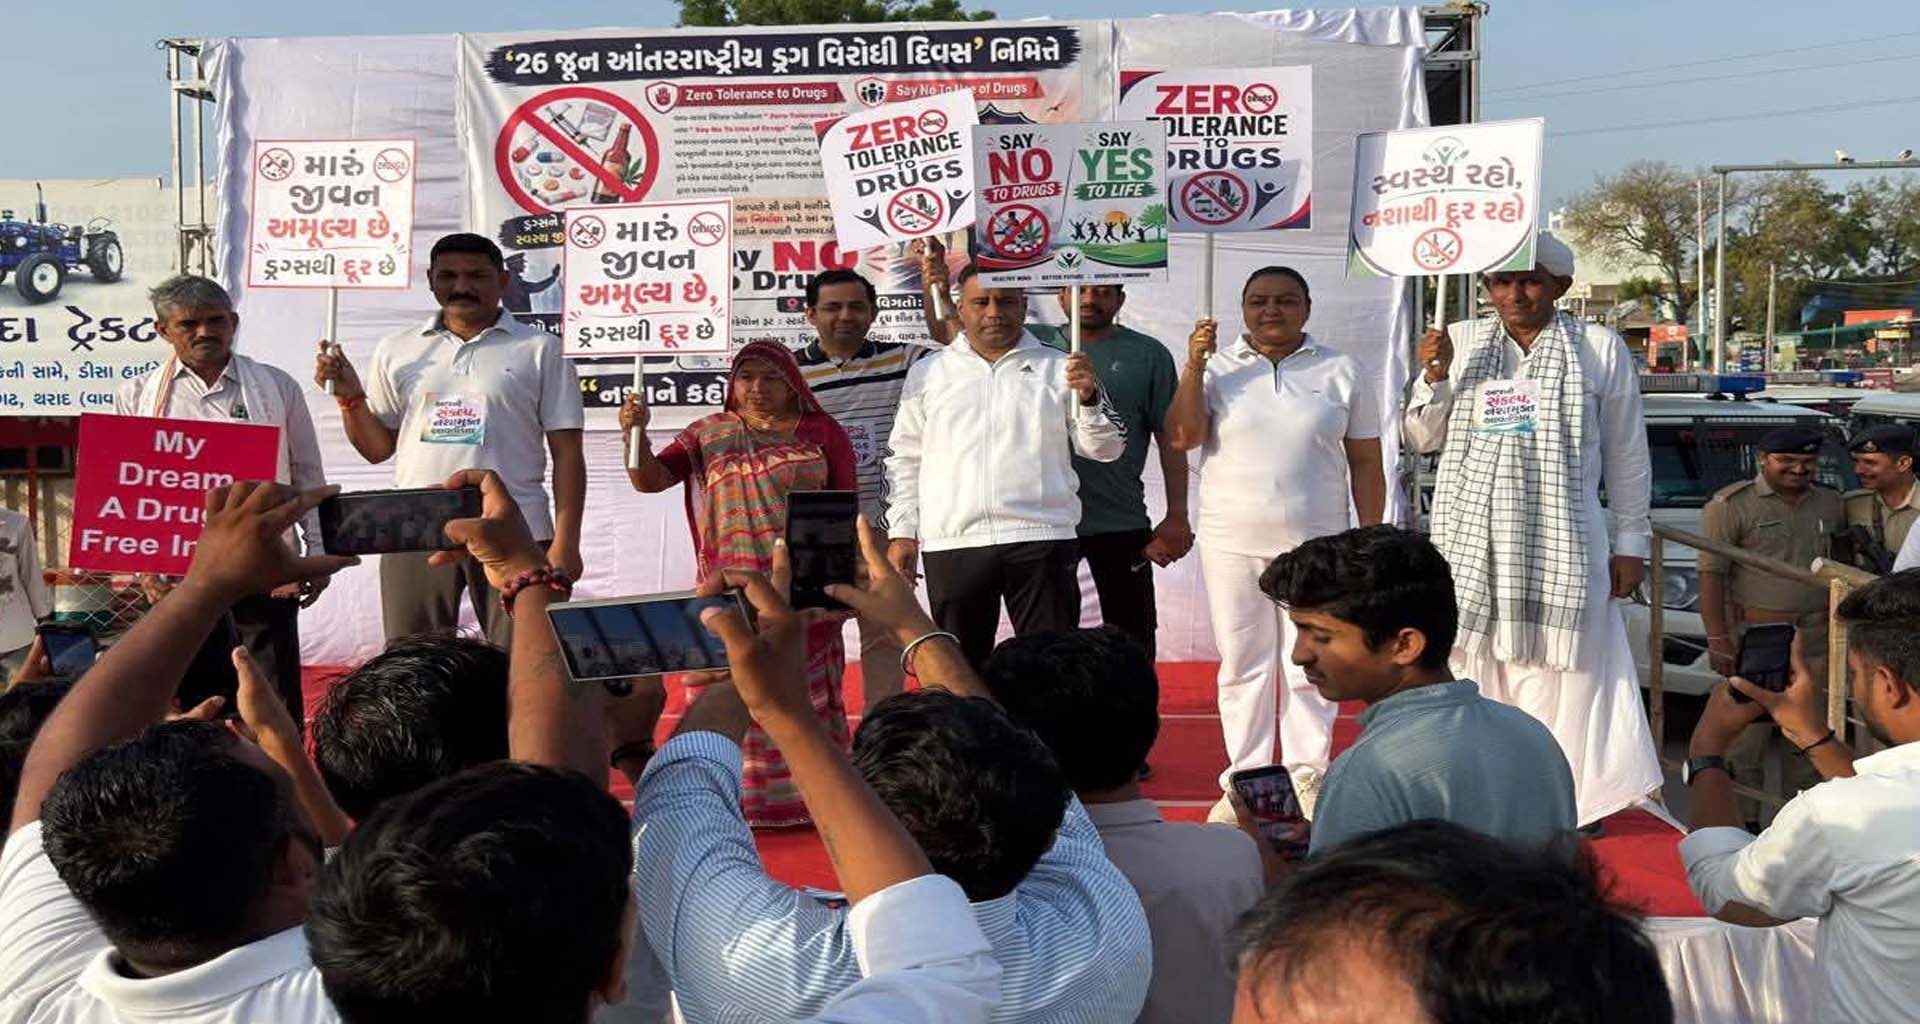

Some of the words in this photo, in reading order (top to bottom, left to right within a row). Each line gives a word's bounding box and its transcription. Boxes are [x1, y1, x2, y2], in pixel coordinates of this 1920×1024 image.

[555, 51, 599, 82] જૂન
[607, 43, 763, 75] આંતરરાષ્ટ્રીય
[772, 47, 809, 73] ડ્રગ
[818, 34, 898, 67] વિરોધી
[686, 89, 713, 101] Zero
[716, 88, 775, 100] Tolerance
[777, 88, 790, 98] to
[792, 87, 828, 100] Drugs
[896, 84, 917, 99] Say
[920, 83, 937, 96] No
[979, 82, 991, 94] of
[992, 82, 1028, 96] Drugs
[1099, 132, 1132, 147] SAY
[1146, 115, 1287, 137] OLERANCE
[844, 131, 962, 171] TOLERANCE
[1000, 133, 1034, 150] SAY
[1203, 138, 1229, 148] TO
[304, 148, 365, 177] મારું
[896, 160, 916, 171] TO
[988, 148, 1053, 186] NO
[1078, 148, 1153, 182] YES
[1371, 164, 1454, 195] સ્વસ્થ
[1466, 156, 1523, 190] રહો,
[855, 160, 963, 197] DRUGS
[991, 187, 1008, 201] TO
[1012, 184, 1055, 199] DRUGS
[1087, 185, 1105, 198] TO
[1111, 183, 1144, 197] LIFE
[289, 185, 381, 214] જીવન
[1362, 196, 1438, 228] નશાથી
[1444, 200, 1475, 229] દૂર
[1483, 192, 1525, 223] રહો
[267, 218, 357, 248] અમૂલ્ય
[367, 210, 399, 243] છે,
[616, 213, 679, 242] મારું
[264, 253, 336, 281] ડ્રગ્સથી
[343, 259, 372, 283] દૂર
[378, 253, 396, 276] છે
[601, 249, 696, 280] જીવન
[580, 281, 672, 314] અમૂલ્ય
[683, 273, 718, 307] છે,
[752, 271, 815, 290] Dru
[65, 305, 158, 352] ટ્રેકટ
[578, 319, 650, 348] ડ્રગ્સથી
[659, 323, 690, 349] દૂર
[696, 318, 715, 341] છે
[32, 361, 69, 382] સામે,
[78, 361, 113, 379] ડીસા
[33, 393, 71, 406] થરાદ
[153, 430, 206, 460] My
[119, 461, 233, 490] Dream
[98, 496, 126, 520] A
[80, 529, 160, 555] Free
